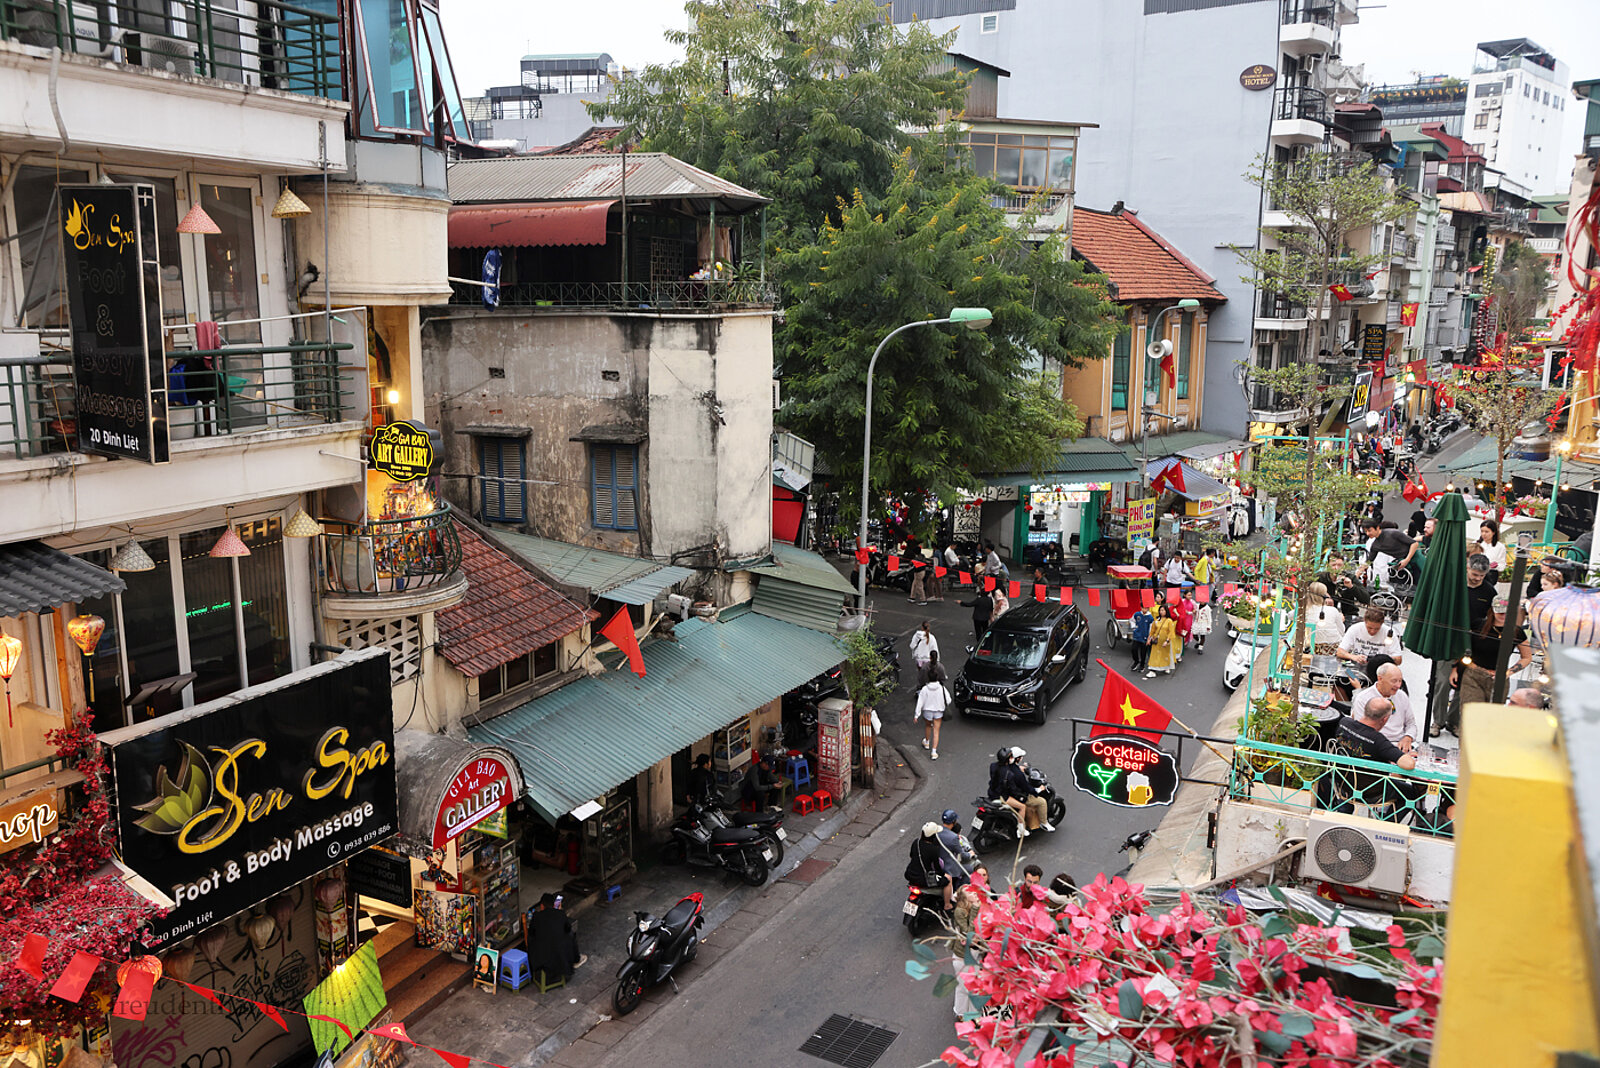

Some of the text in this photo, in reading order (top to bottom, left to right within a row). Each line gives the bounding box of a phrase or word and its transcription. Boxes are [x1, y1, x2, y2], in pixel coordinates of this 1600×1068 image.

[1245, 77, 1270, 86] HOTEL
[74, 202, 134, 254] Sen Spa
[97, 304, 113, 336] &
[79, 384, 144, 428] Massage
[90, 427, 101, 444] 20
[123, 434, 139, 454] Liệt
[411, 434, 426, 447] BAO
[377, 443, 428, 467] ART GALLERY
[1091, 741, 1159, 764] Cocktails
[1104, 757, 1145, 771] & Beer
[178, 728, 390, 854] Sen Spa
[449, 760, 497, 798] GIA BAO
[468, 778, 480, 792] Art
[444, 775, 508, 829] GALLERY
[344, 837, 363, 852] 0938
[363, 830, 377, 842] 039
[1374, 834, 1405, 845] SAMSUNG
[174, 803, 374, 908] Foot & Body Massage
[197, 911, 213, 925] Liệt
